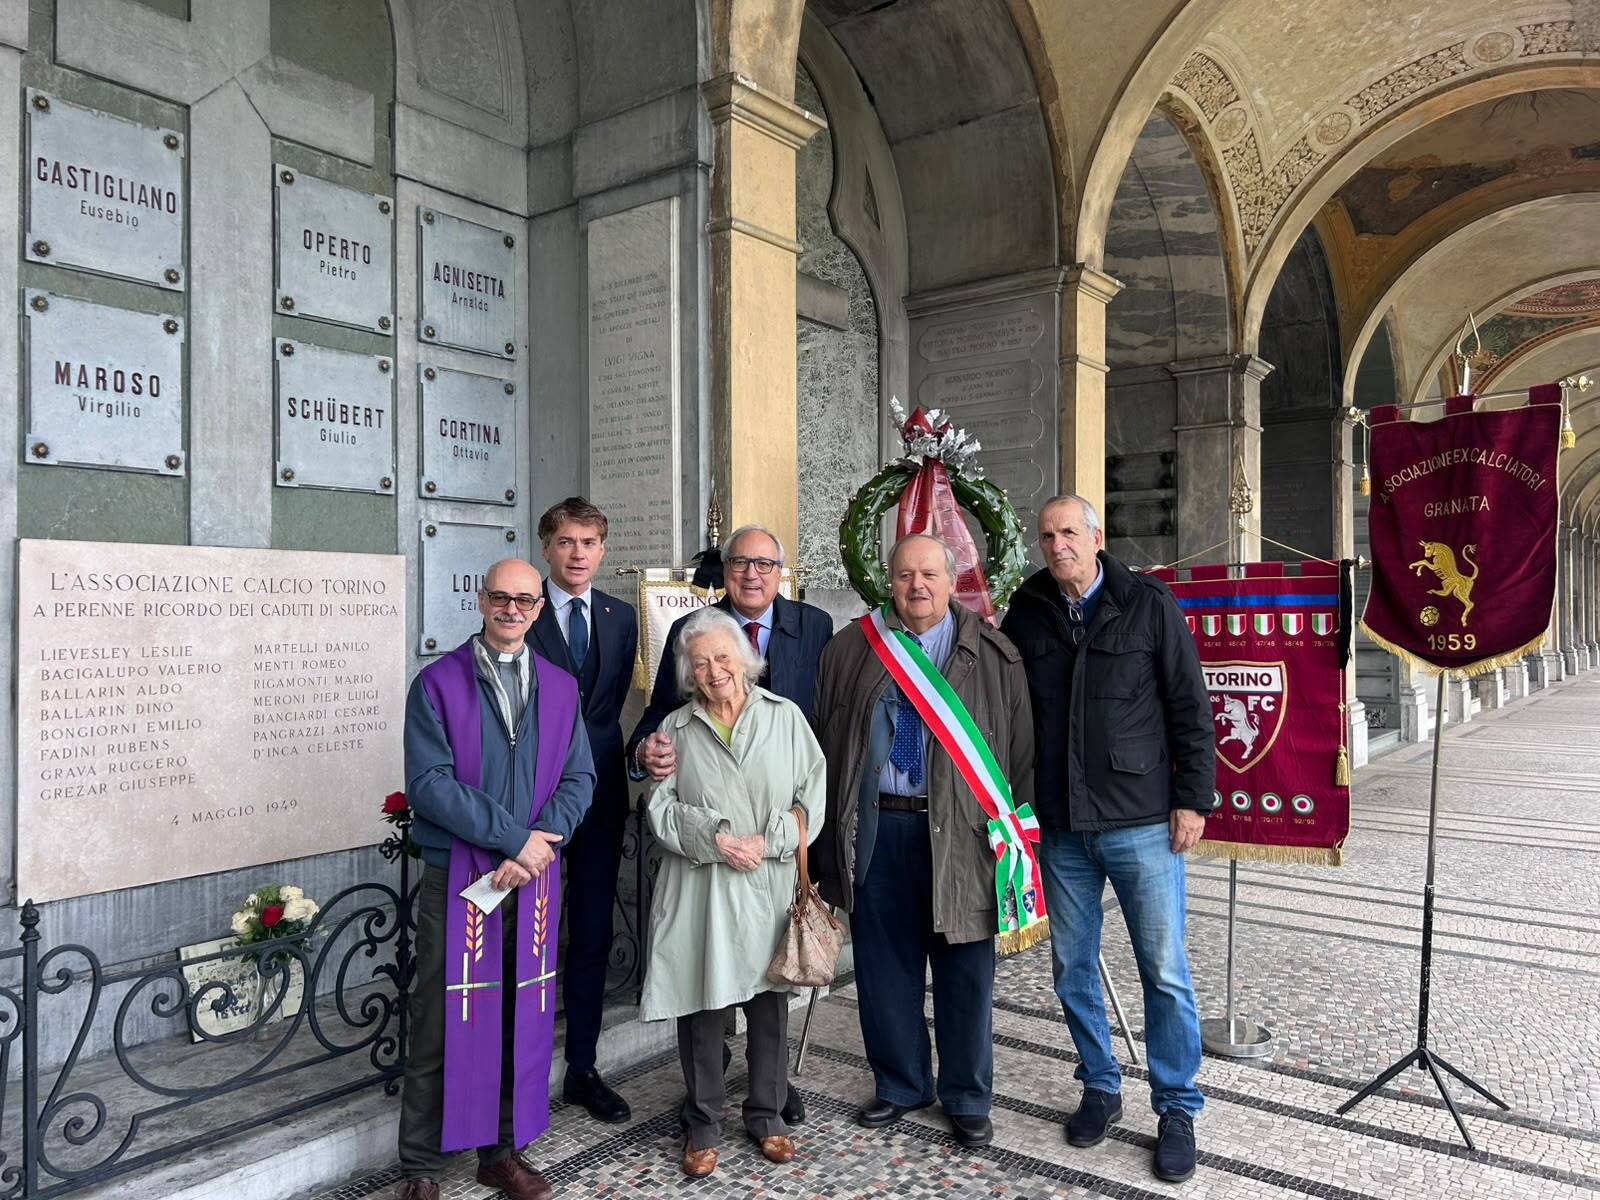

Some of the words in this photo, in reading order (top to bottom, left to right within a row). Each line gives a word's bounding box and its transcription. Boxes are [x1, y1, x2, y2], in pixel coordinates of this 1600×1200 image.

[37, 157, 177, 214] CASTIGLIANO
[80, 200, 140, 228] Eusebio
[303, 229, 372, 265] OPERTO
[319, 260, 357, 281] Pietro
[433, 262, 506, 299] AGNISETTA
[452, 293, 489, 312] Arnaldo
[54, 361, 162, 397] MAROSO
[78, 396, 141, 419] Virgilio
[287, 396, 385, 429] SCHÜBERT
[319, 427, 357, 446] Giulio
[439, 418, 502, 446] CORTINA
[452, 445, 490, 462] Ottavio
[1453, 448, 1469, 463] EX
[1470, 447, 1546, 492] CALCIATORI
[1424, 496, 1490, 518] GRANATA
[50, 572, 233, 594] L'ASSOCIAZIONE
[243, 576, 313, 595] CALCIO
[321, 578, 386, 595] TORINO
[453, 574, 484, 593] LOI
[33, 603, 46, 618] A
[54, 602, 136, 618] PERENNE
[143, 602, 223, 618] RICORDO
[228, 603, 254, 617] DEI
[260, 603, 314, 618] CADUTI
[319, 603, 334, 617] DI
[338, 603, 399, 618] SUPERGA
[656, 595, 719, 608] TORINO
[253, 642, 318, 655] MARTELLI
[325, 640, 370, 653] DANILO
[1427, 634, 1477, 650] 1959
[40, 646, 131, 662] LIEVESLEY
[140, 645, 193, 659] LESLIE
[40, 665, 149, 681] BACIGALUPO
[158, 662, 222, 676] VALERIO
[253, 660, 294, 672] MENTI
[301, 658, 347, 670] ROMEO
[253, 675, 328, 690] RIGAMONTI
[334, 673, 374, 685] MARIO
[1205, 672, 1272, 687] TORINO
[40, 684, 126, 702] BALLARIN
[136, 682, 183, 697] ALDO
[253, 693, 306, 707] MERONI
[312, 691, 340, 704] PIER
[347, 689, 379, 702] LUIGI
[40, 704, 125, 722] BALLARIN
[135, 702, 174, 716] DINO
[1247, 695, 1275, 712] FC
[253, 708, 327, 725] BIANCIARDI
[334, 705, 380, 719] CESARE
[40, 722, 137, 742] BONGIORNI
[146, 718, 202, 733] EMILIO
[253, 725, 325, 743] PANGRAZZI
[333, 720, 388, 735] ANTONIO
[40, 745, 97, 761] FADINI
[107, 739, 170, 755] RUBENS
[307, 738, 364, 754] CELESTE
[40, 763, 98, 782] GRAVA
[108, 755, 188, 774] RUGGERO
[40, 781, 108, 802] GREZAR
[119, 772, 197, 793] GIUSEPPE
[171, 813, 180, 826] 4
[191, 804, 255, 824] MAGGIO
[265, 798, 299, 815] 1949
